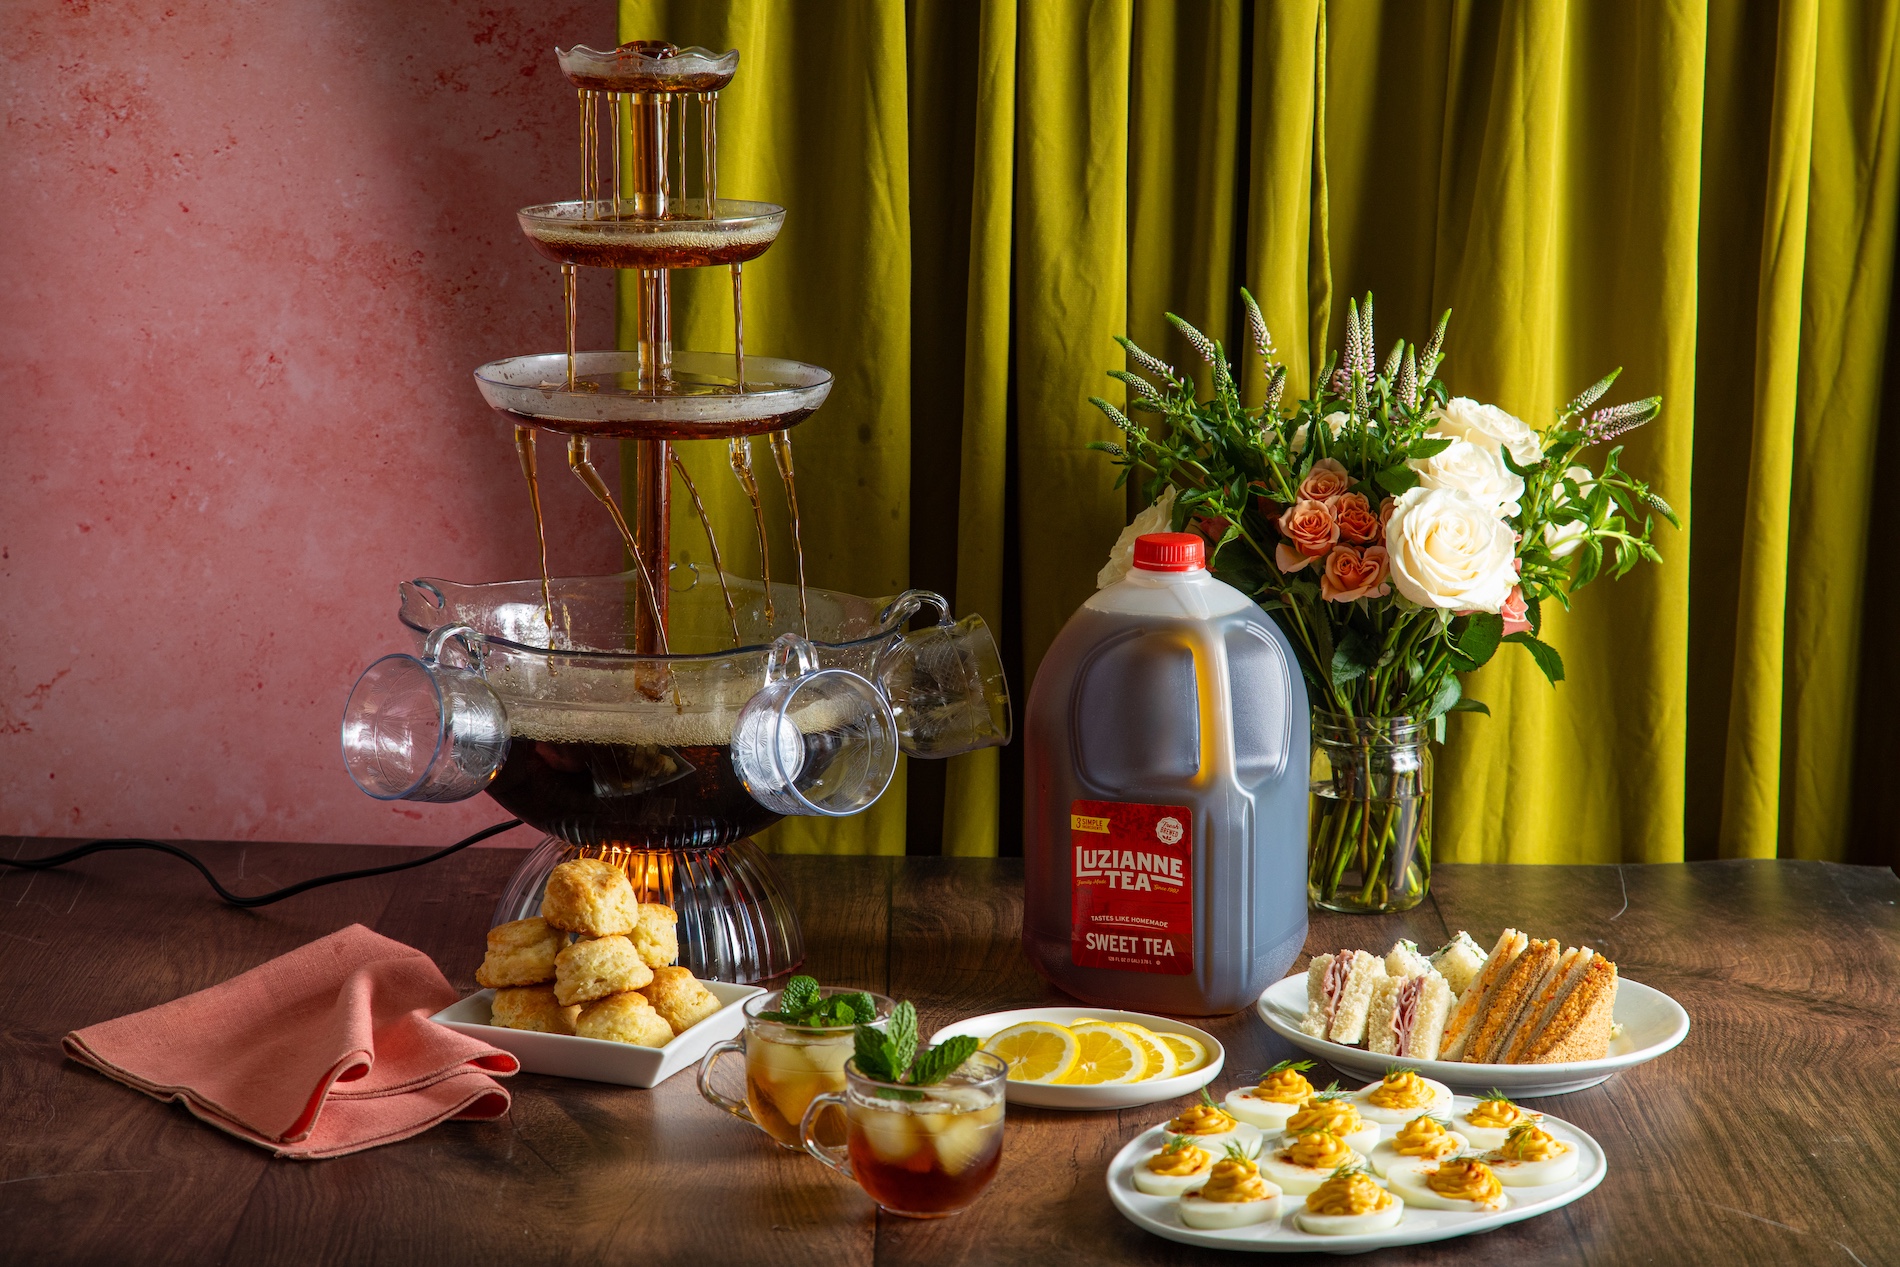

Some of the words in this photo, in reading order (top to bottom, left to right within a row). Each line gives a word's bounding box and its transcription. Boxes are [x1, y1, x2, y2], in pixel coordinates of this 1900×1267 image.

[1076, 817, 1081, 828] 3
[1082, 818, 1103, 826] SIMPLE
[1160, 827, 1179, 838] BREWED
[1076, 846, 1183, 878] LUZIANNE
[1104, 870, 1151, 892] TEA
[1131, 917, 1169, 928] HOMEMADE
[1086, 932, 1139, 954] SWEET
[1142, 938, 1175, 957] TEA
